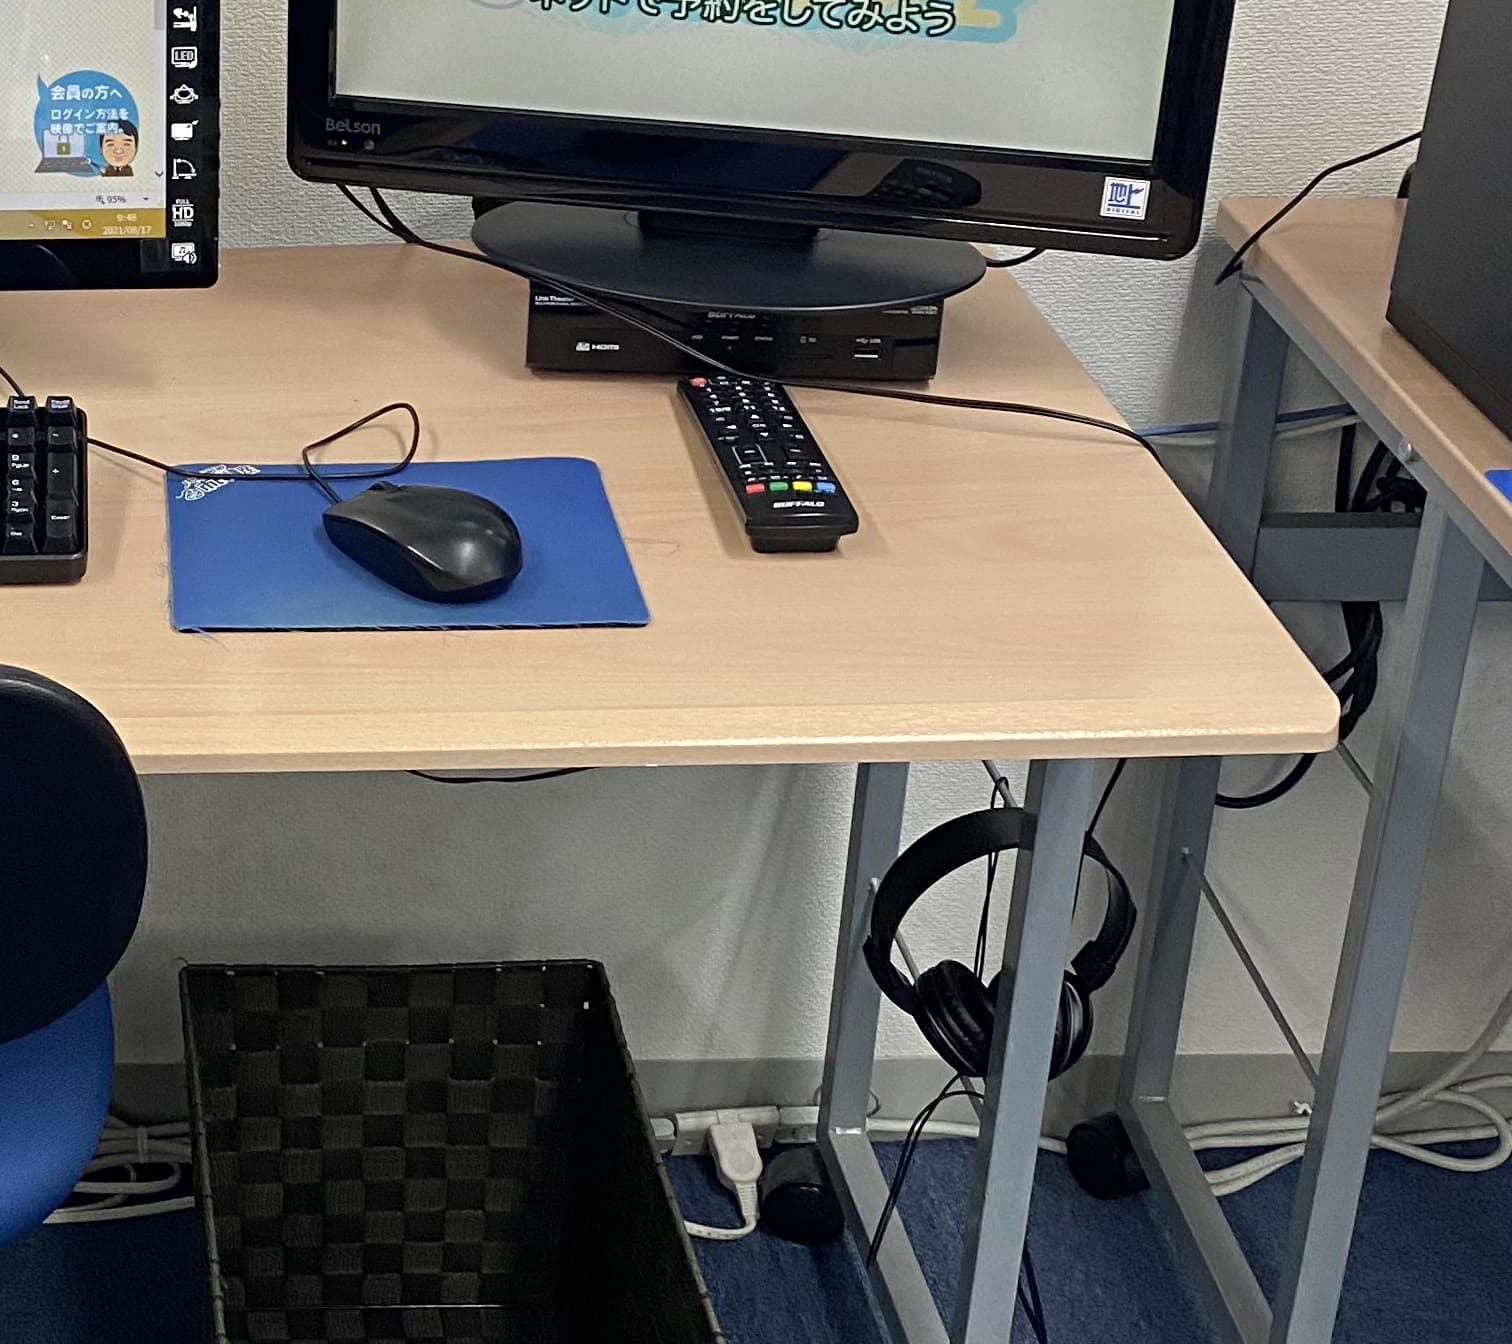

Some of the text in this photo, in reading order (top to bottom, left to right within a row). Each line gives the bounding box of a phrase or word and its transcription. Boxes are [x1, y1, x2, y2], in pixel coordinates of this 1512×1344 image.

[50, 84, 123, 102] 会員の方へ
[50, 108, 129, 121] ログイン方法を
[325, 117, 382, 135] Belson
[172, 207, 194, 219] HD
